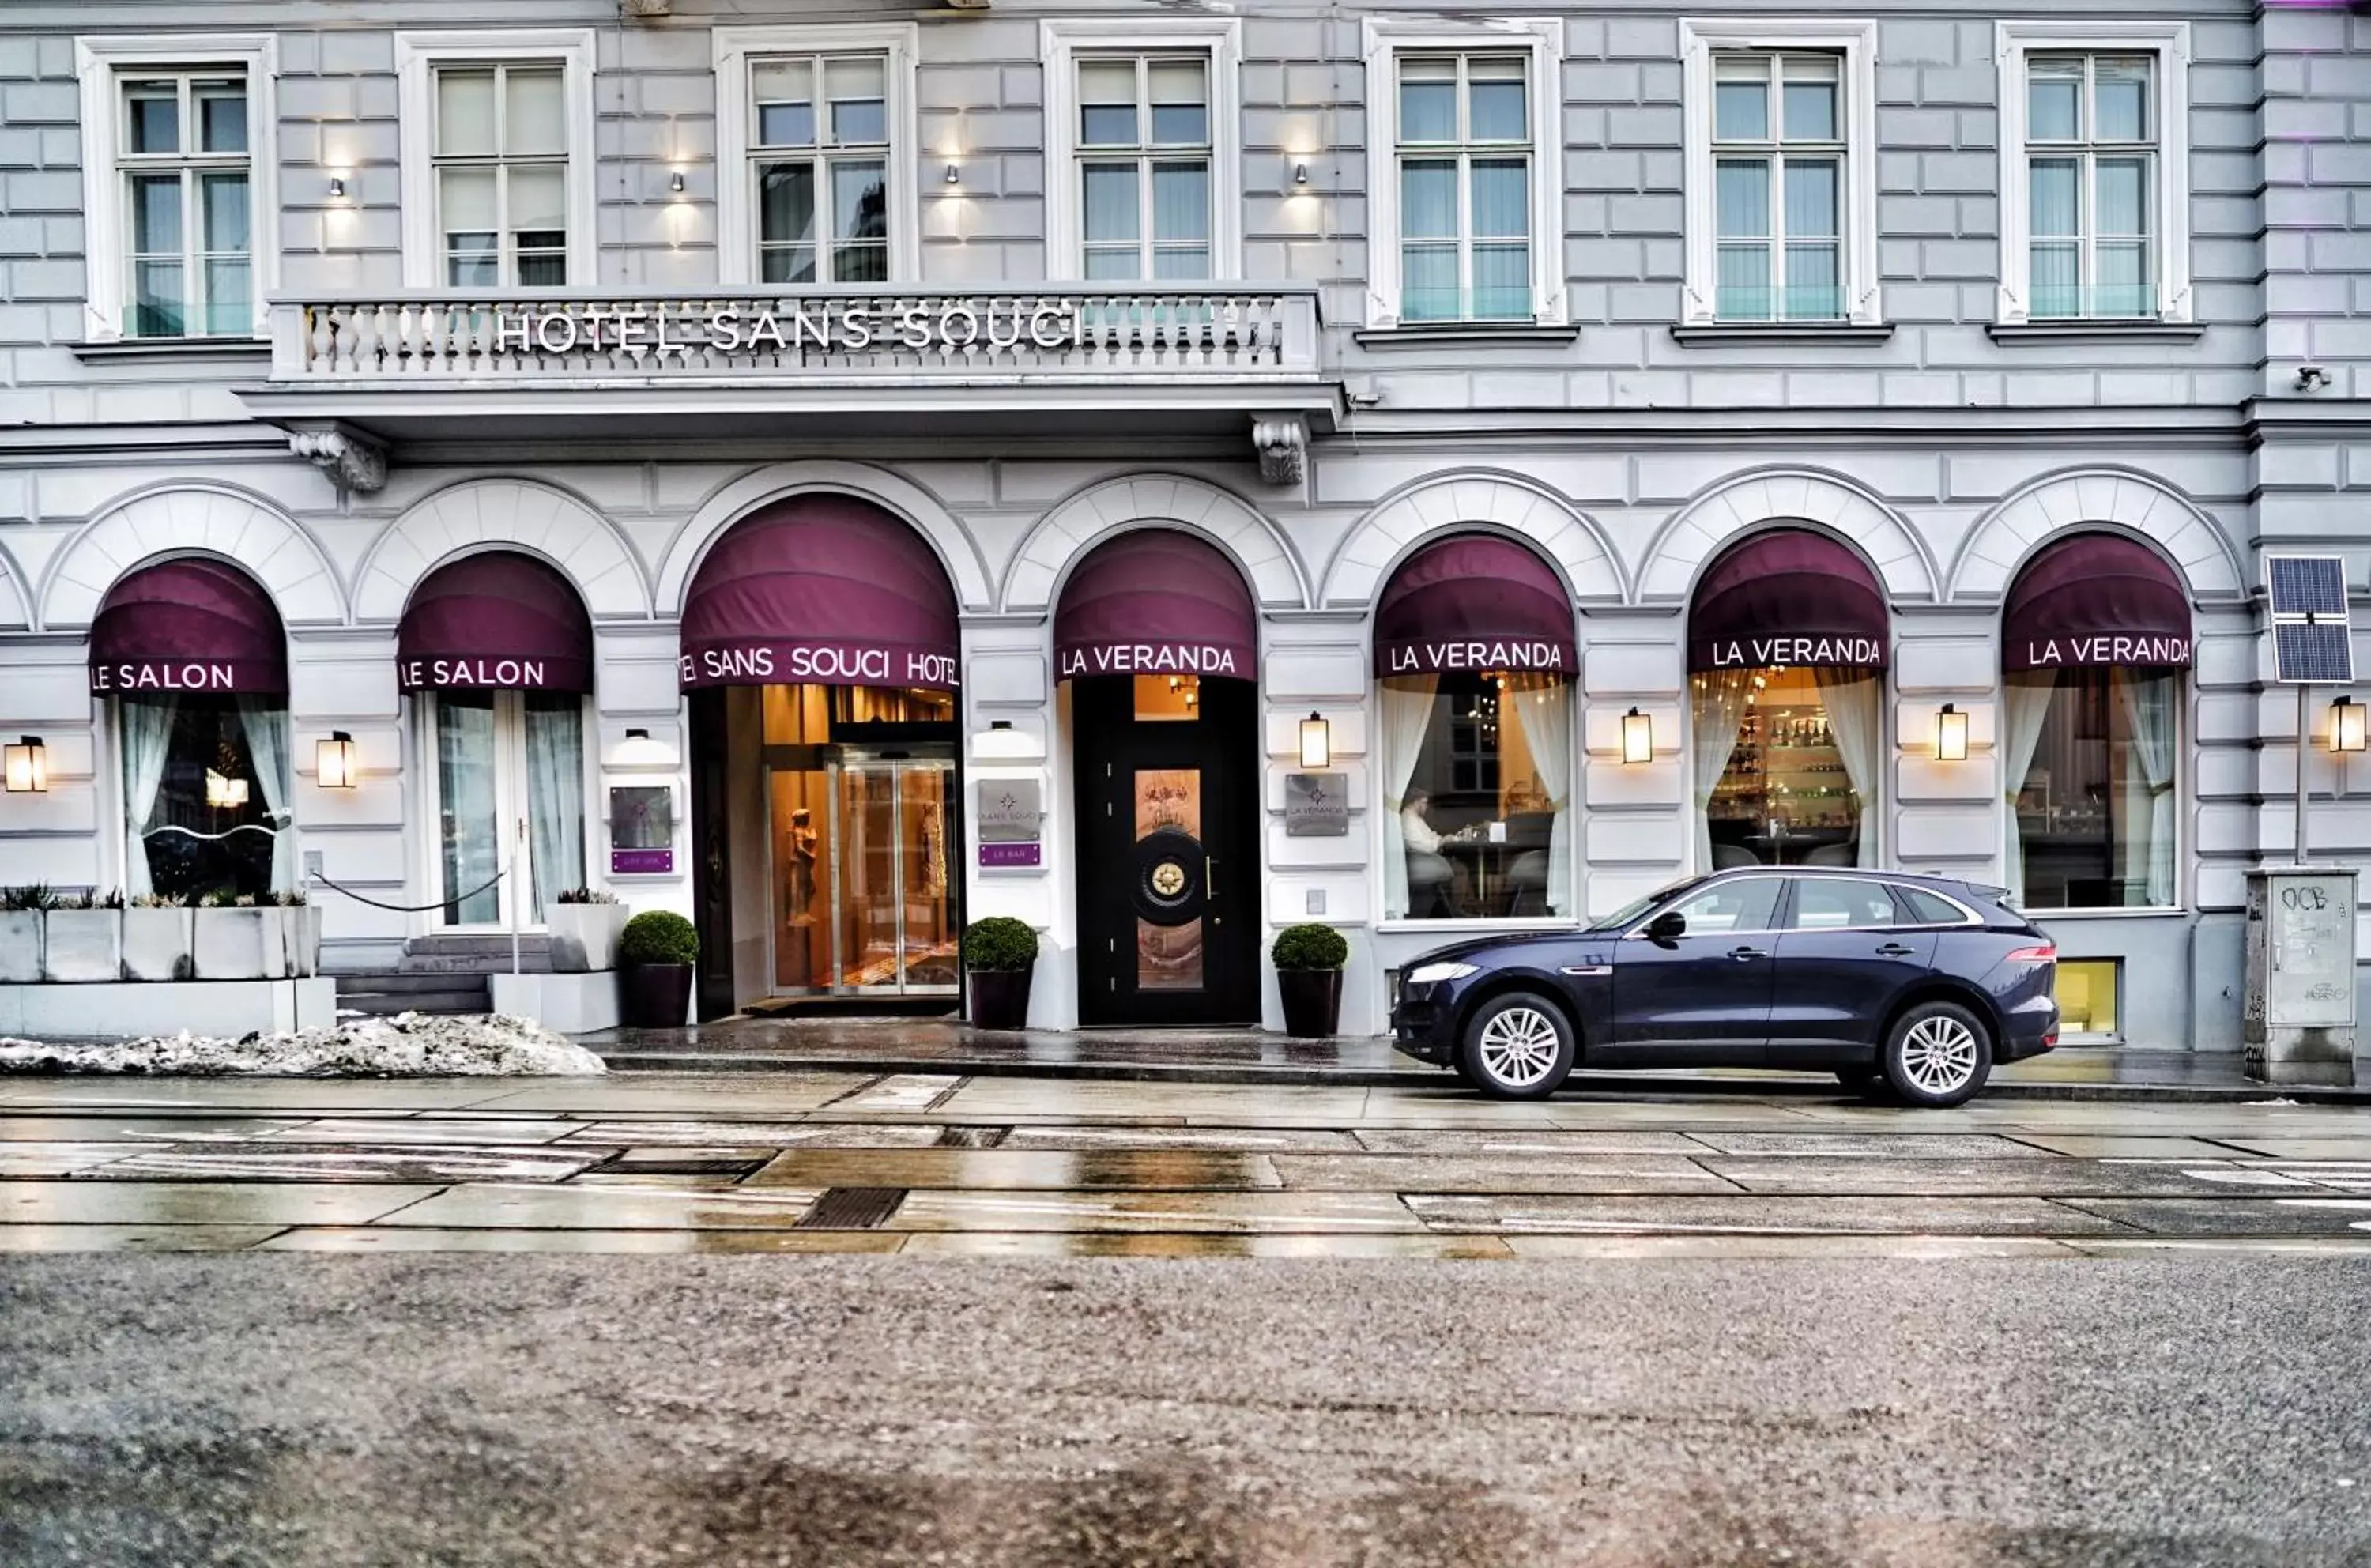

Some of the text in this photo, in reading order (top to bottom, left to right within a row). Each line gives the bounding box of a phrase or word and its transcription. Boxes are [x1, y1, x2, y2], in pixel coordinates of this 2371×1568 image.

[497, 307, 1082, 352] HOTEL SANS SOUCI
[1062, 645, 1235, 675] LA VERANDA
[1391, 642, 1562, 671] LA VERANDA
[1713, 638, 1880, 665] LA VERANDA
[2029, 636, 2190, 665] LA VERANDA
[91, 664, 234, 690] LE SALON
[401, 659, 544, 687] LE SALON
[704, 646, 774, 677] SANS
[790, 647, 888, 678] SOUCI
[907, 652, 960, 687] HOTEL
